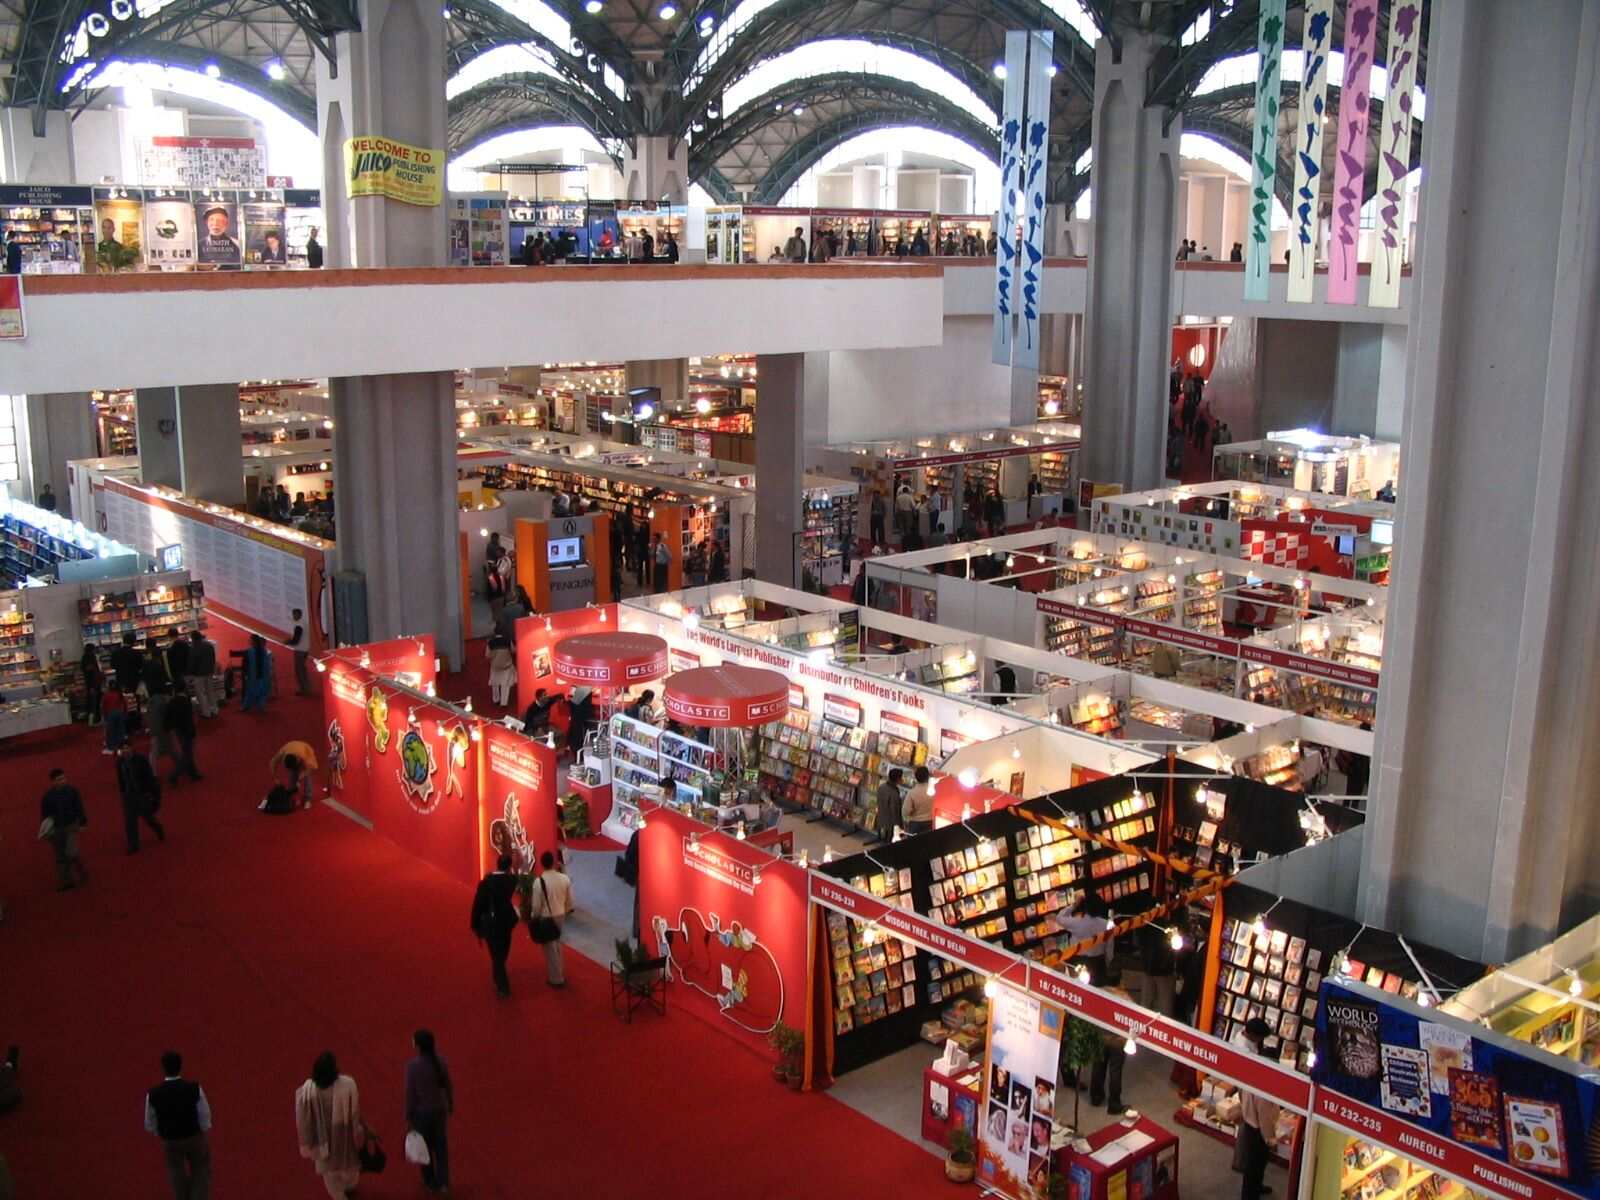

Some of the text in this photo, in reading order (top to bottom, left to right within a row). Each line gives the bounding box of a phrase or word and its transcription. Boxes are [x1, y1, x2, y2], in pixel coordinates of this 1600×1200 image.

[351, 139, 432, 163] WELCOME TO
[351, 152, 436, 180] JAICO PUBLISHING
[396, 169, 424, 183] HOUSE
[550, 576, 594, 592] PENGUIN
[699, 631, 725, 650] World's
[727, 640, 753, 658] Largest
[754, 647, 790, 669] Publisher
[800, 663, 842, 685] Distributor
[854, 678, 896, 701] Children's
[885, 912, 912, 932] WISDOM
[912, 924, 930, 941] TREE,
[931, 934, 946, 946] NEW
[947, 941, 966, 956] DELHI
[1328, 1005, 1378, 1024] WORLD
[1328, 1016, 1379, 1031] MYTHOLOGY
[1113, 1012, 1147, 1033] WISDOM
[1173, 1037, 1192, 1052] NEW
[1193, 1045, 1218, 1064] DELHI
[1455, 1079, 1492, 1108] 365
[1323, 1100, 1533, 1197] 18/ 232-235 AUREOLE PUBLISHING
